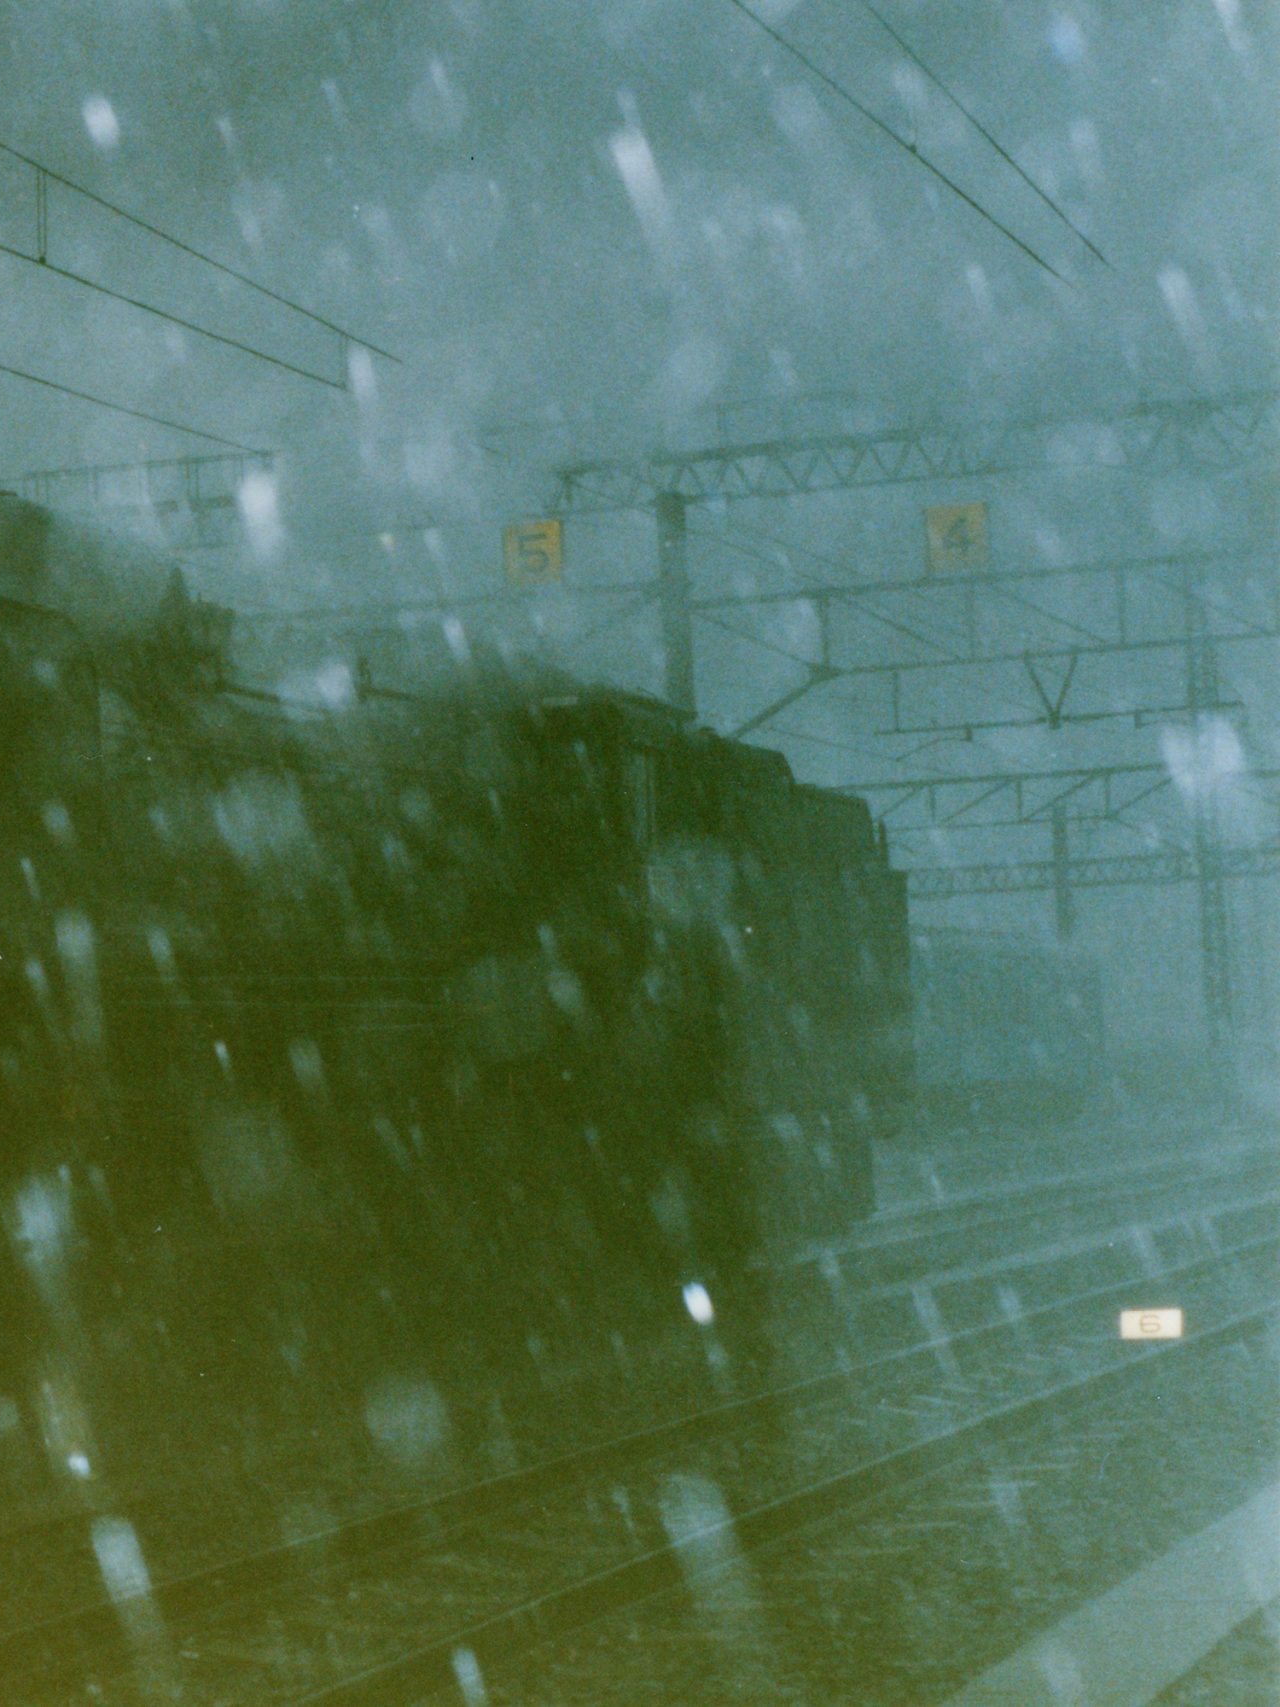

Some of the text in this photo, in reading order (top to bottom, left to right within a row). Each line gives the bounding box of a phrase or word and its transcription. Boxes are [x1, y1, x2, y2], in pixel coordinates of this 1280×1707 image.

[519, 532, 551, 575] 5
[941, 516, 971, 554] 4
[1138, 1313, 1161, 1334] 6
